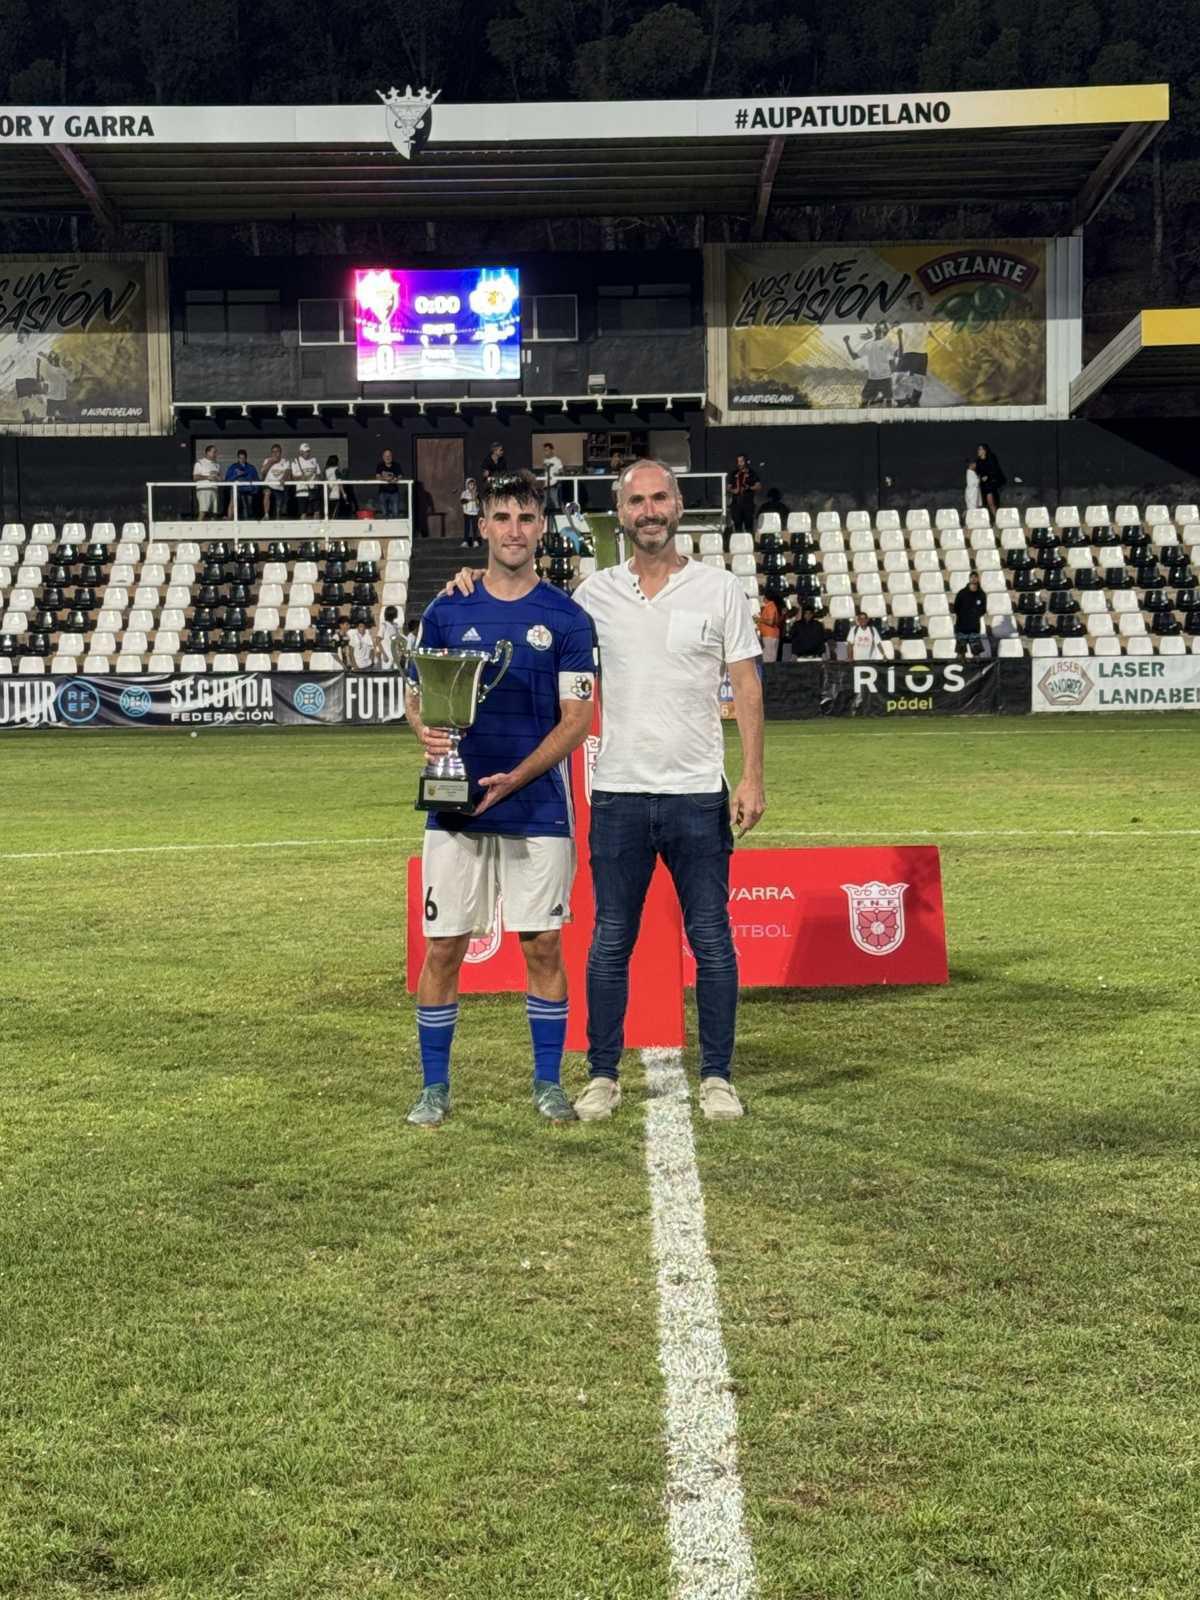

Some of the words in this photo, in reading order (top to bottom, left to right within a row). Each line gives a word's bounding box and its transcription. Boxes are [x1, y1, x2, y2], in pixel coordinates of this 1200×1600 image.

[38, 115, 54, 137] Y
[64, 115, 155, 137] GARRA
[735, 101, 951, 129] #AUPATUDELANO
[13, 265, 80, 300] UNE
[743, 272, 791, 302] NOS
[795, 259, 857, 294] UNE
[927, 255, 1027, 283] URZANTE
[735, 300, 762, 327] LA
[763, 273, 911, 326] PASIÓN
[377, 344, 394, 375] 0
[483, 344, 500, 375] 0
[1098, 661, 1165, 678] LASER
[170, 678, 273, 708] SEGUNDA
[886, 696, 933, 712] pádel
[170, 709, 274, 722] FEDERACIÓN
[424, 886, 438, 921] 6
